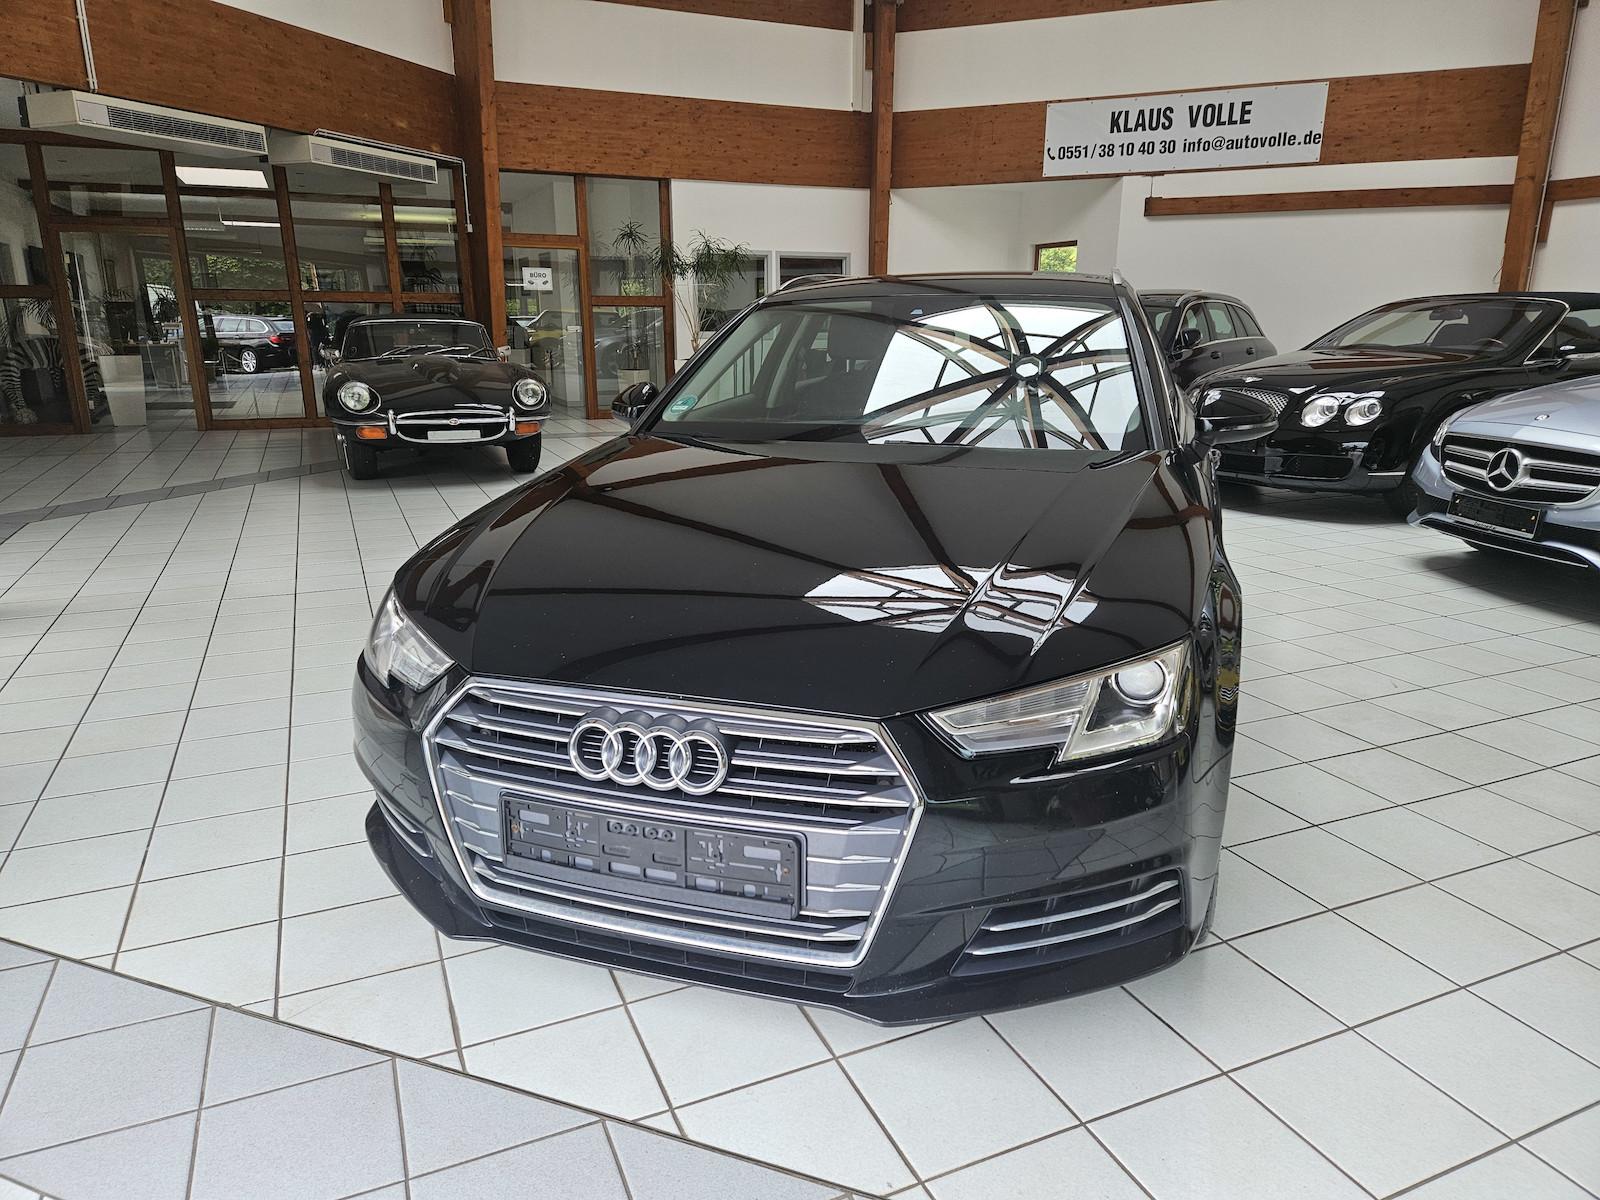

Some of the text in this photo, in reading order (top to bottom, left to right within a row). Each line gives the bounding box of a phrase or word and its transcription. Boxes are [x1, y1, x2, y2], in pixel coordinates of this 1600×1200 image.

[1109, 100, 1253, 133] KLAUS VOLLE
[1118, 142, 1135, 157] 10
[1138, 140, 1155, 155] 40
[1159, 139, 1176, 154] 30
[1182, 130, 1322, 153] info@autovolle.de
